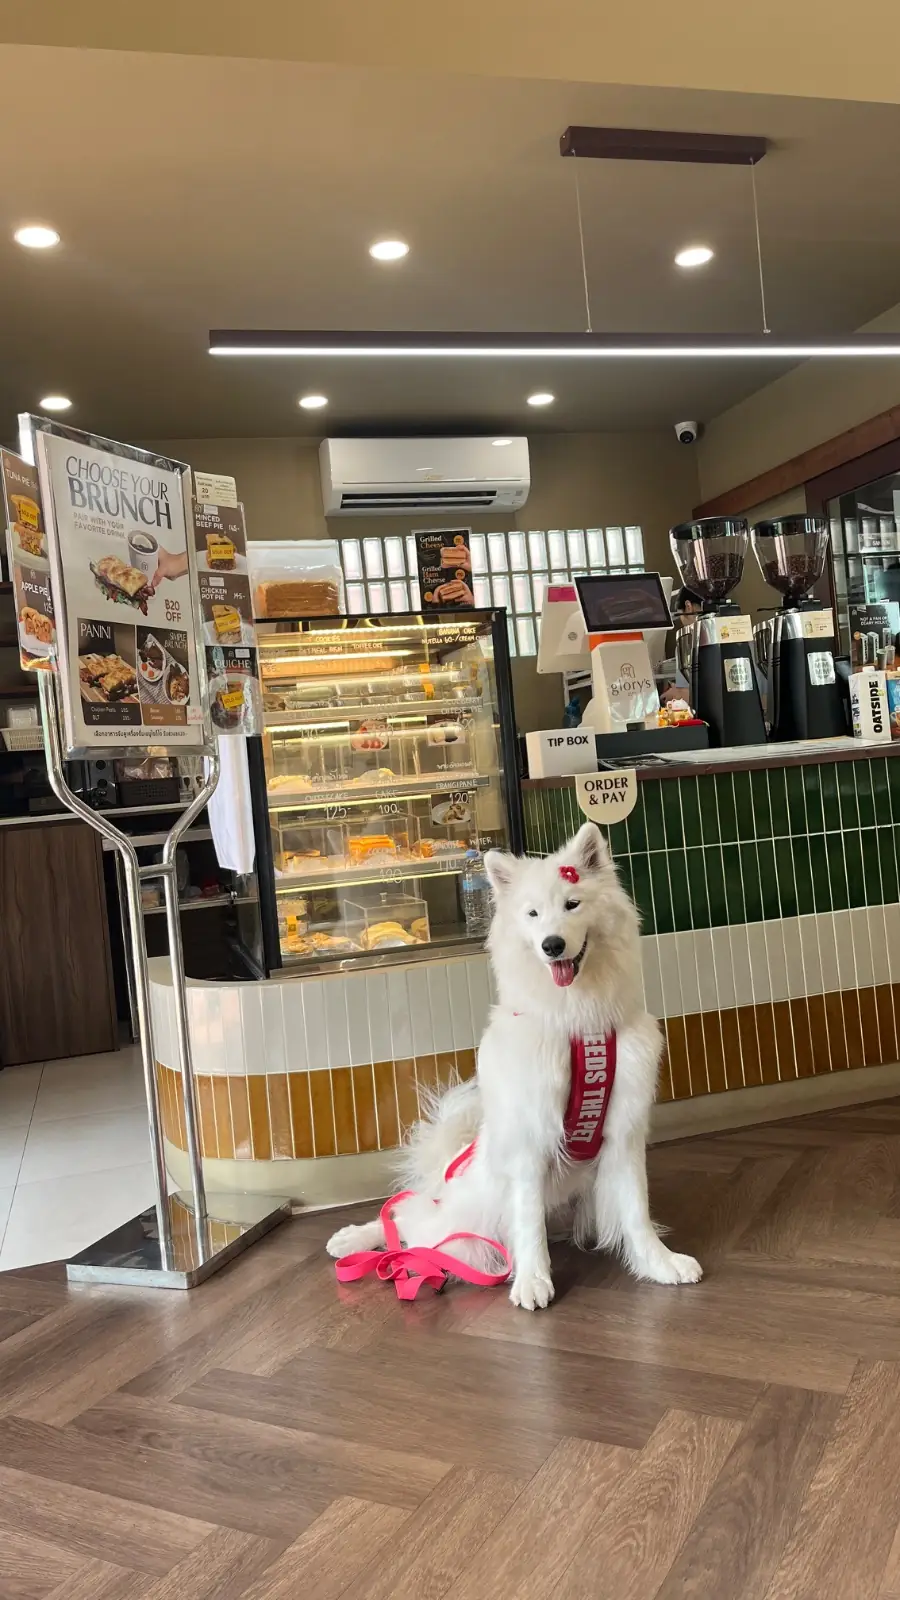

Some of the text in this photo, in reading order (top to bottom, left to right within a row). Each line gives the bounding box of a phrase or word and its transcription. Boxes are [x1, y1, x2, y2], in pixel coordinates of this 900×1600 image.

[66, 456, 168, 502] CHOOSE YOUR
[68, 476, 172, 530] BRUNCH
[195, 513, 221, 523] MINCED
[74, 521, 106, 535] FAVORITE
[196, 520, 213, 529] BEEF
[213, 522, 224, 530] PIE
[420, 535, 442, 543] Grilled
[421, 541, 445, 549] Cheese
[422, 565, 442, 573] Grilled
[423, 577, 446, 586] Cheese
[21, 581, 48, 596] APPLE PIE
[201, 587, 228, 595] CHICKEN
[165, 611, 182, 623] OFF
[80, 622, 111, 640] PANINI
[610, 678, 651, 697] glory's
[869, 681, 883, 734] OATSIDE
[547, 735, 589, 748] TIP BOX
[584, 777, 628, 792] ORDER
[589, 792, 627, 806] & PAY
[469, 836, 493, 846] WATER
[570, 1028, 608, 1143] EEDS THE PET
